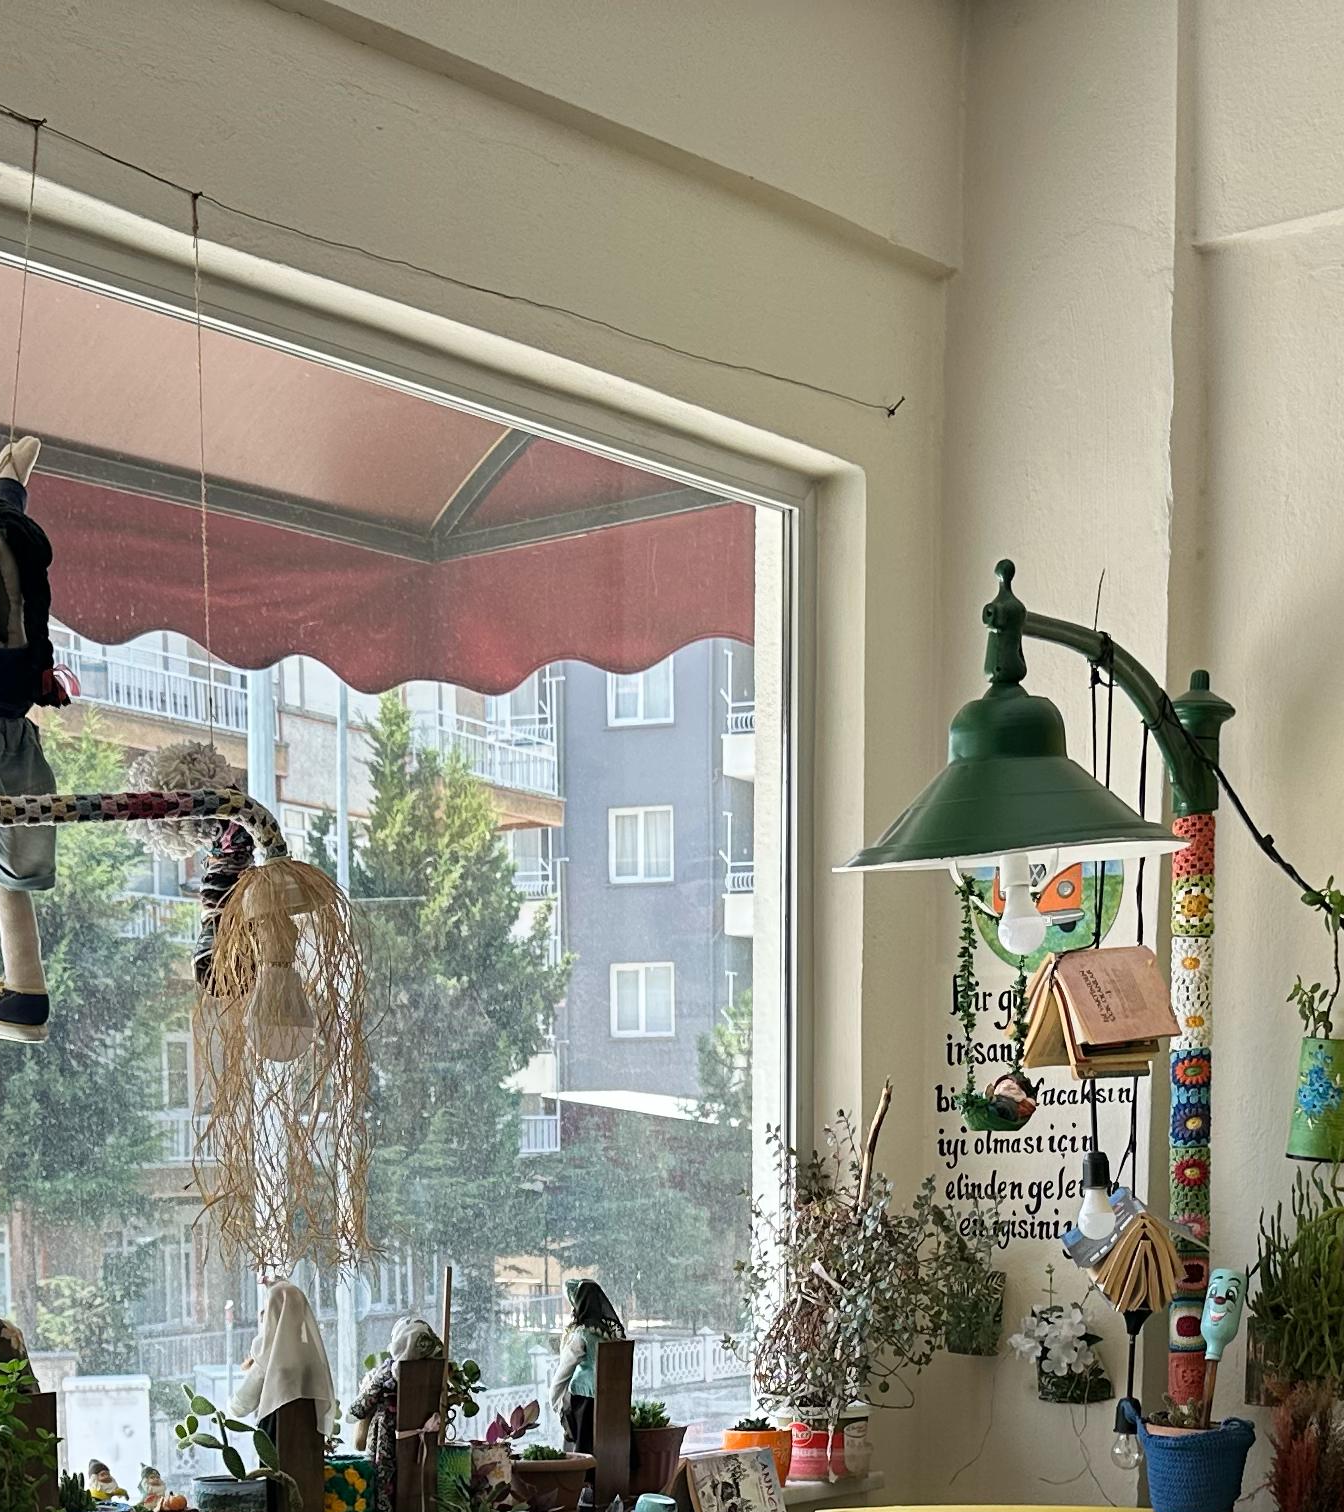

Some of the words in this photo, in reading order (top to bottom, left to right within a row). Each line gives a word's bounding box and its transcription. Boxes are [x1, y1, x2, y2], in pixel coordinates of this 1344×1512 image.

[937, 1126, 969, 1169] iyi
[974, 1129, 1044, 1155] olması
[945, 1169, 1023, 1200] elinden
